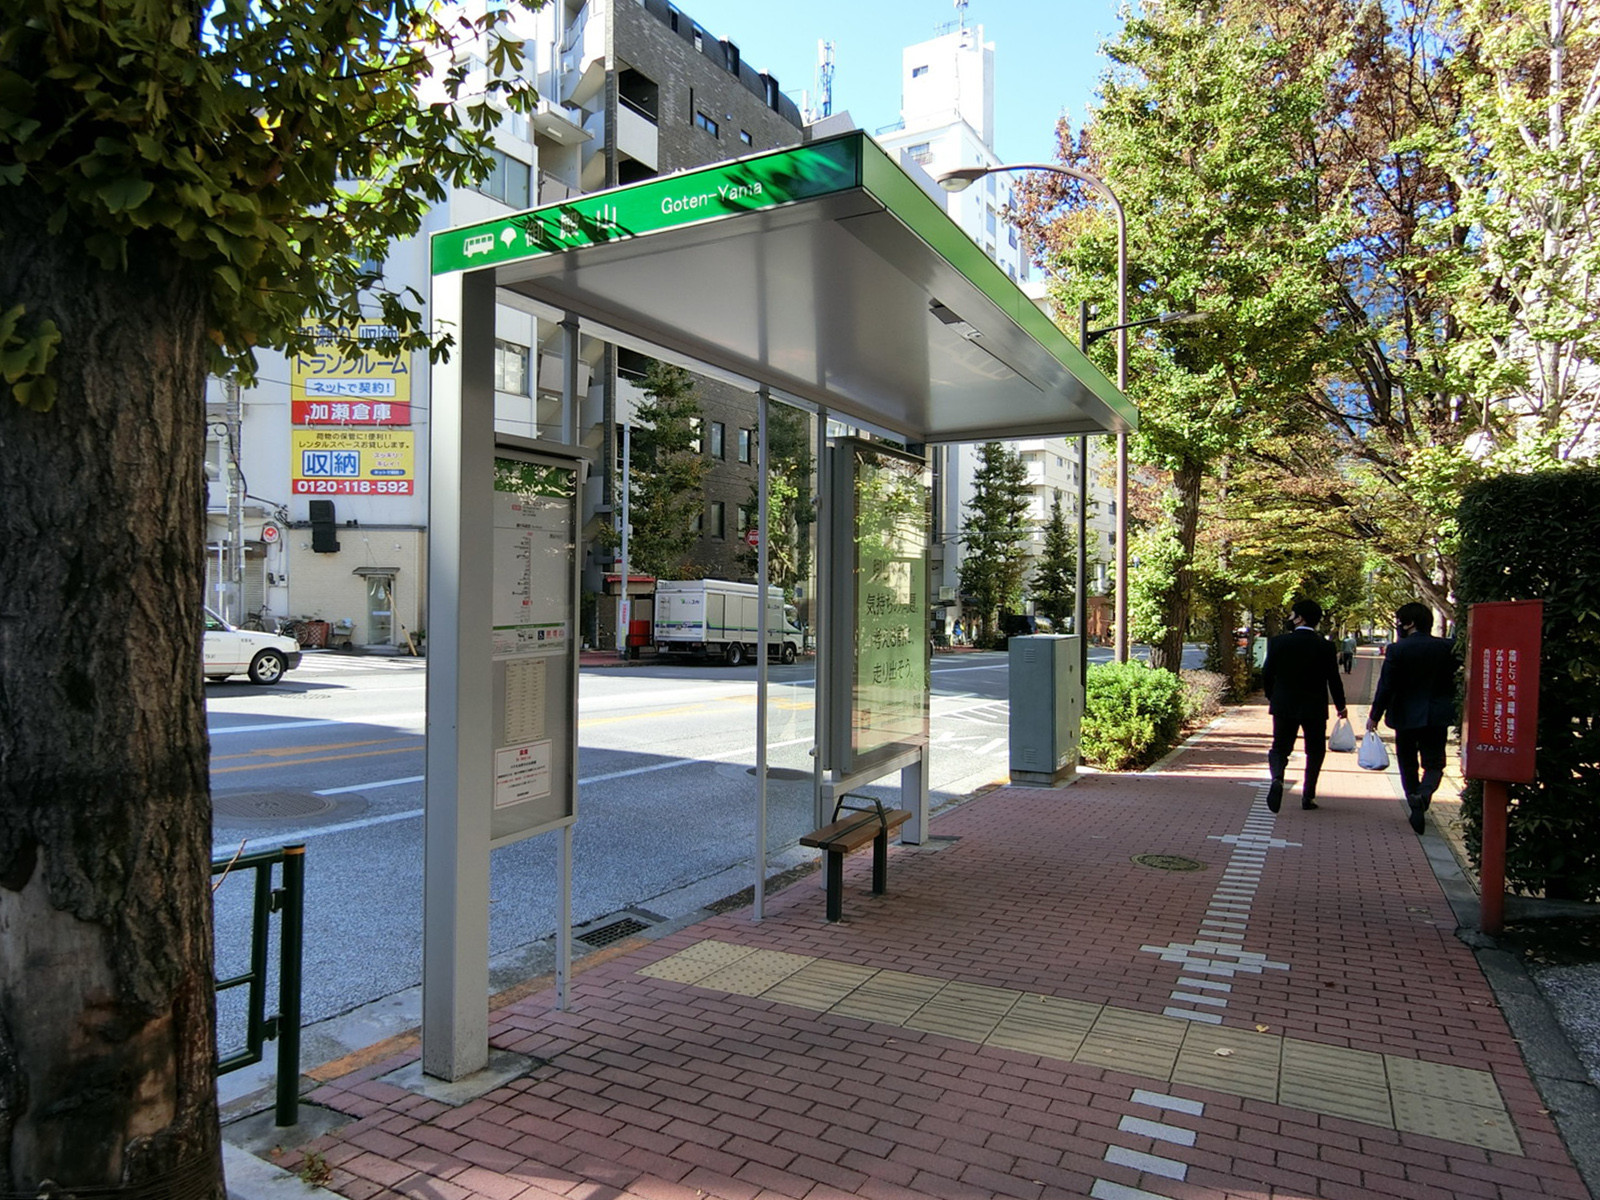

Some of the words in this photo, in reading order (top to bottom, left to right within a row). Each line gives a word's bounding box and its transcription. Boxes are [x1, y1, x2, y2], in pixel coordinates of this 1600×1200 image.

[660, 181, 763, 215] Goten-Yama
[297, 353, 408, 375] トランクルーム
[310, 403, 392, 420] 加瀬倉庫
[306, 453, 357, 474] 収納
[298, 482, 408, 493] 0120-118-592
[873, 659, 914, 685] 走り出そう。
